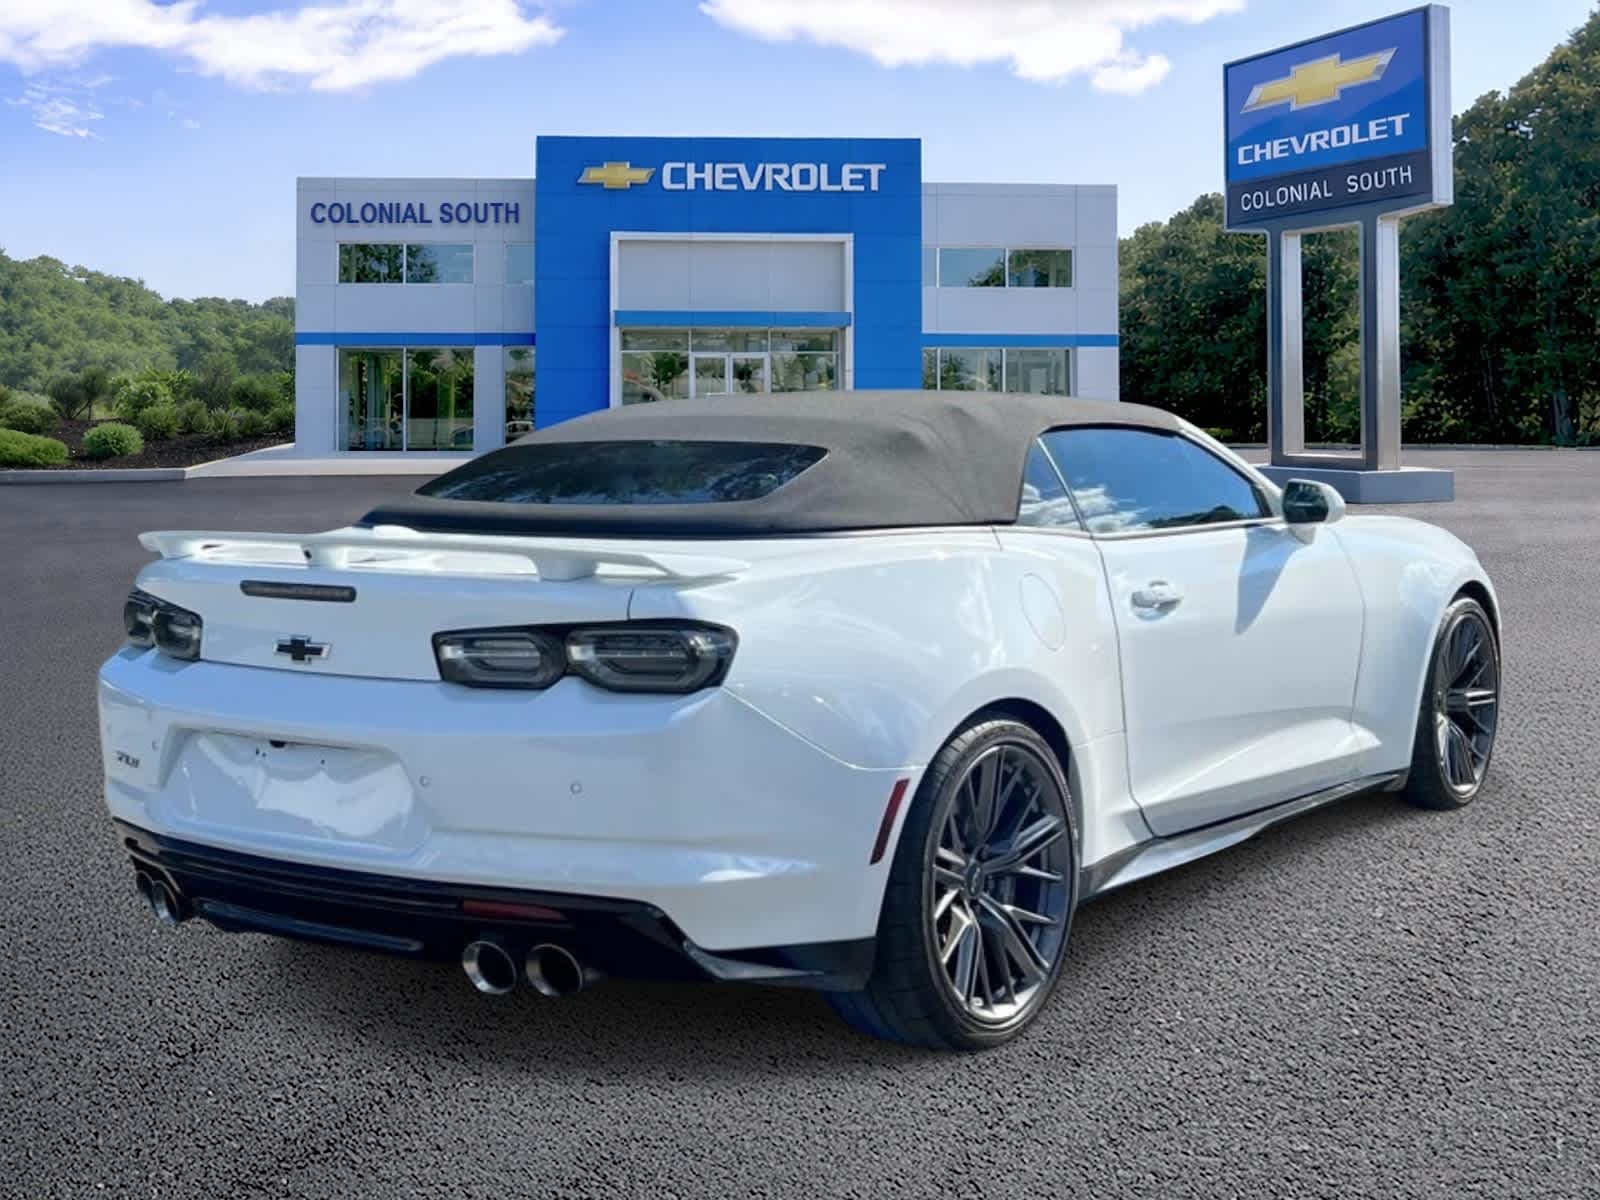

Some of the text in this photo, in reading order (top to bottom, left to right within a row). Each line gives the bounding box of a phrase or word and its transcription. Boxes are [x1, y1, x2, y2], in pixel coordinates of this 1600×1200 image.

[1237, 113, 1410, 165] CHEVROLET
[662, 162, 886, 193] CHEVROLET
[1241, 166, 1412, 211] COLONIAL SOUTH
[310, 202, 521, 225] COLONIAL SOUTH
